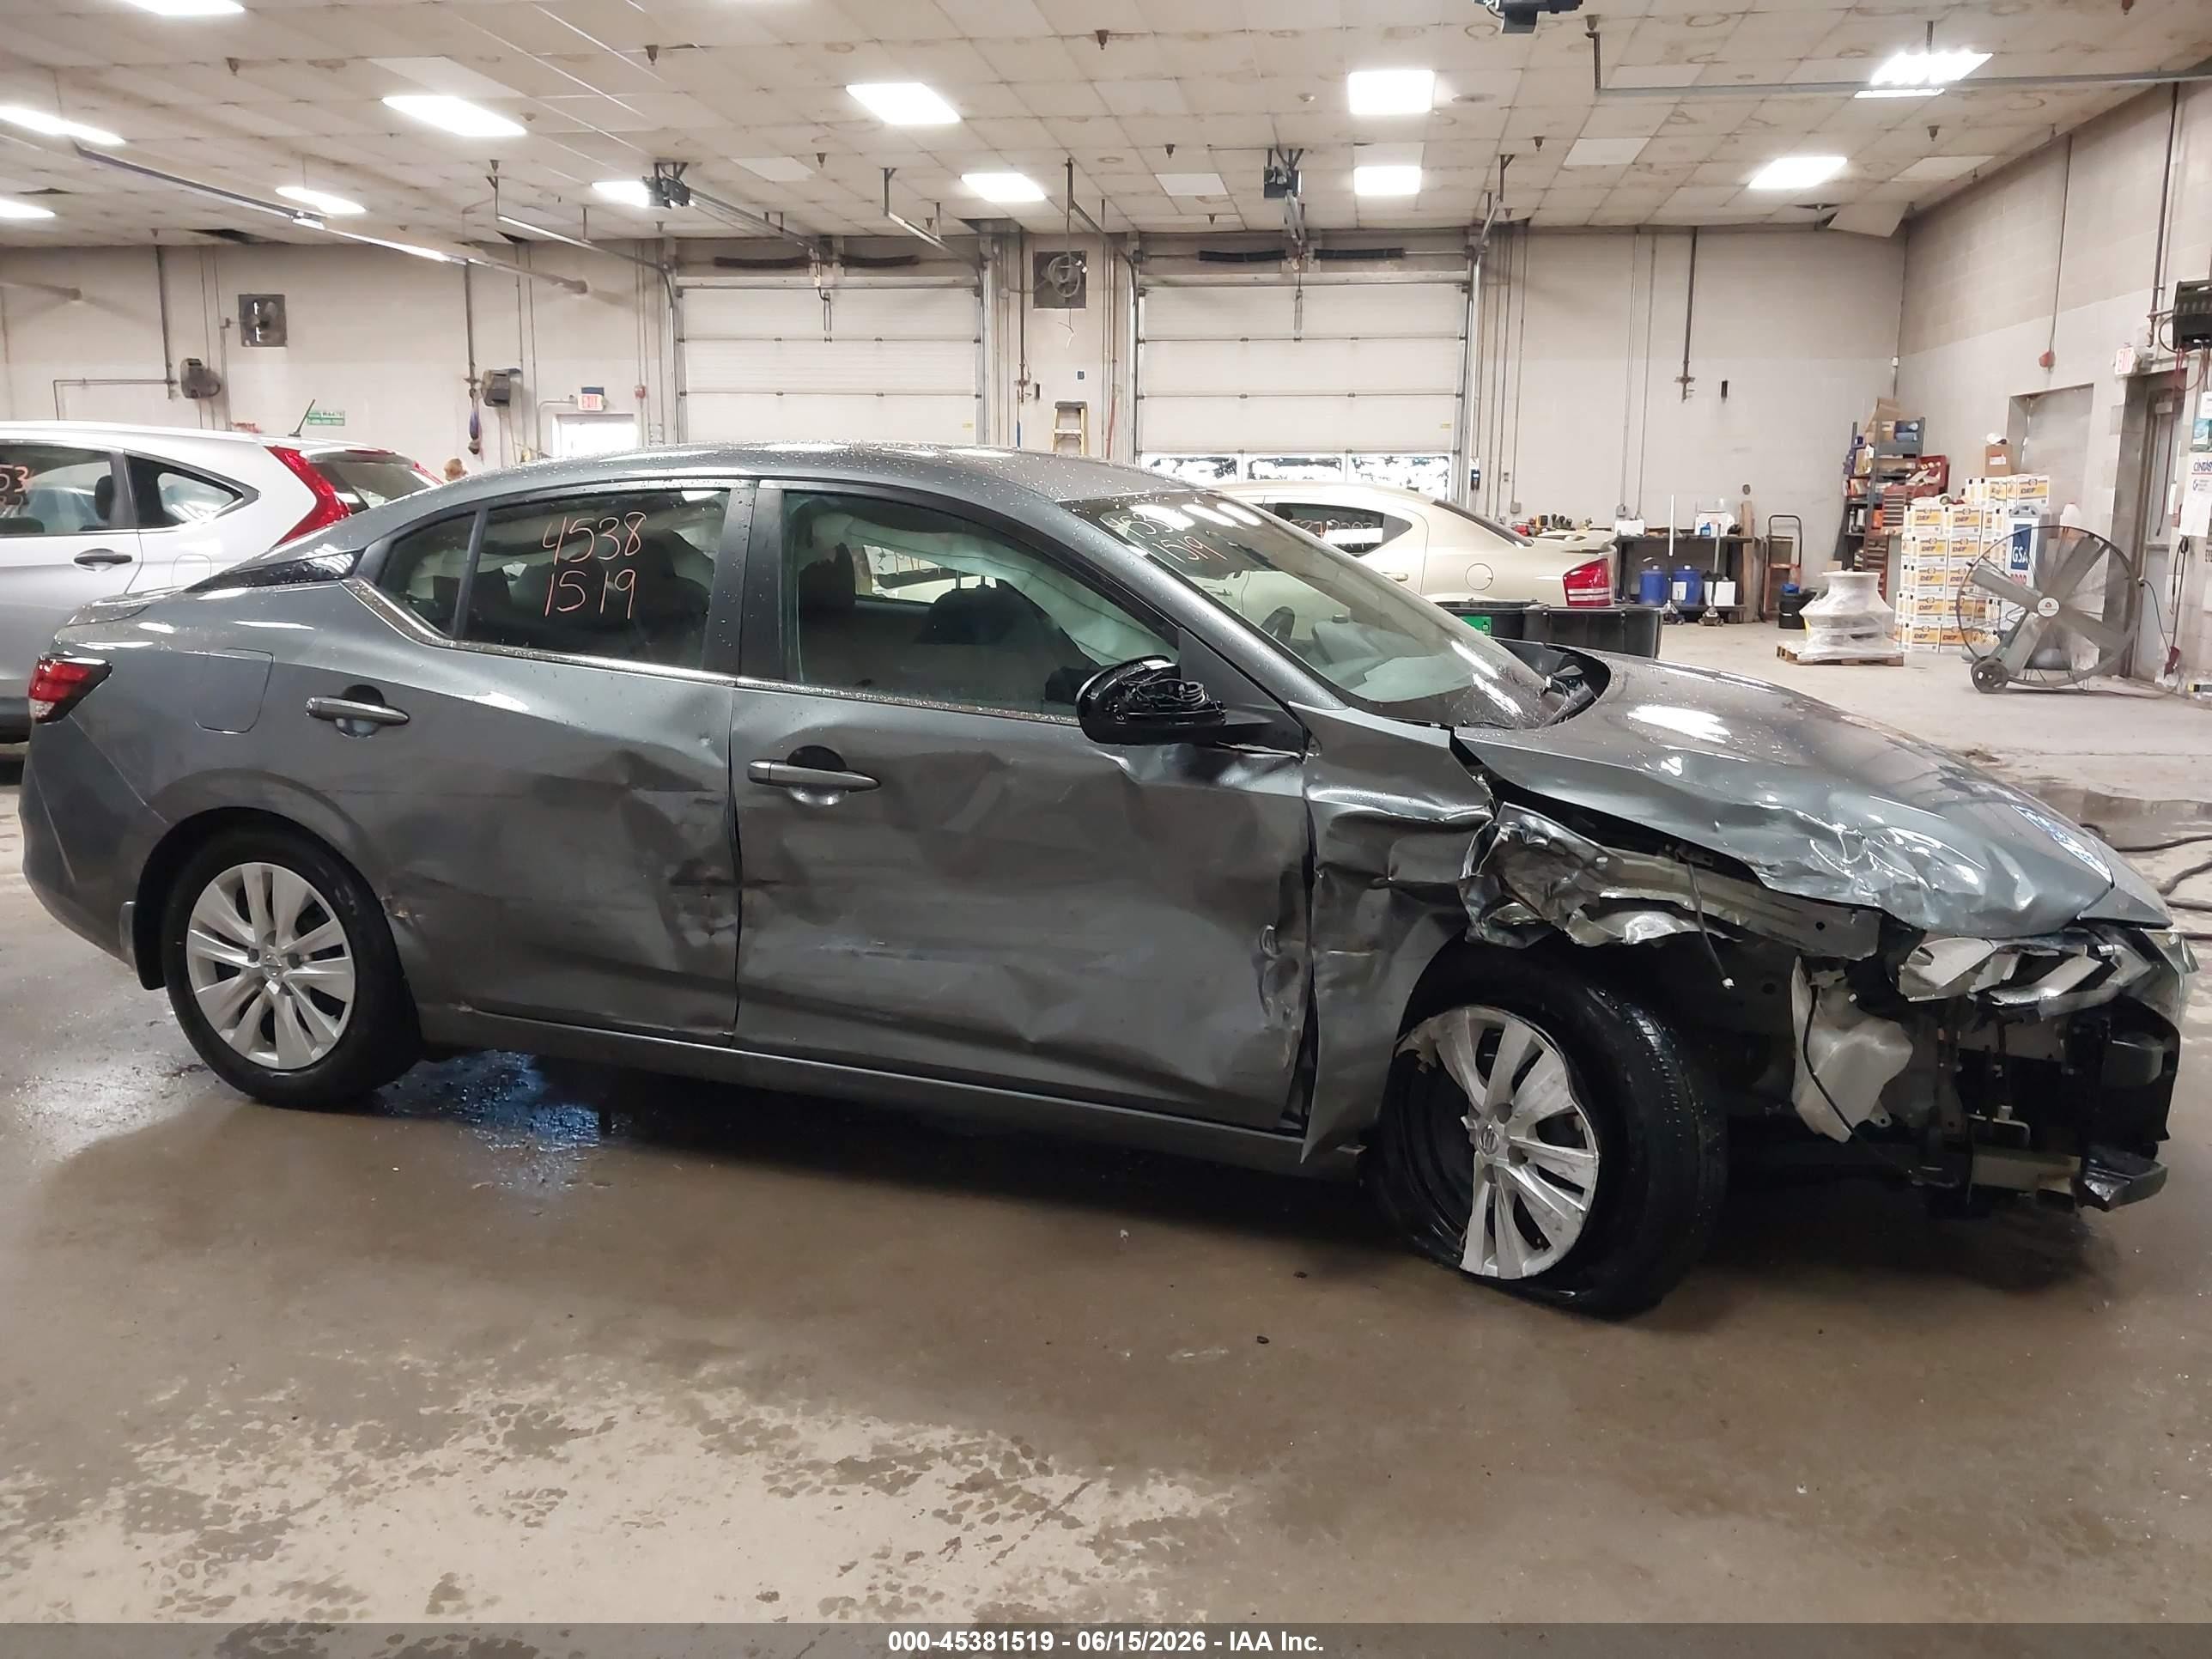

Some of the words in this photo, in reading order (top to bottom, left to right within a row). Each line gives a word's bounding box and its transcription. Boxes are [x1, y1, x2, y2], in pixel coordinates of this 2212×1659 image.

[543, 512, 647, 566] 4538
[1099, 512, 1184, 539] 453
[1152, 535, 1228, 563] 1519
[2012, 546, 2028, 563] GSA
[544, 569, 636, 619] 1519
